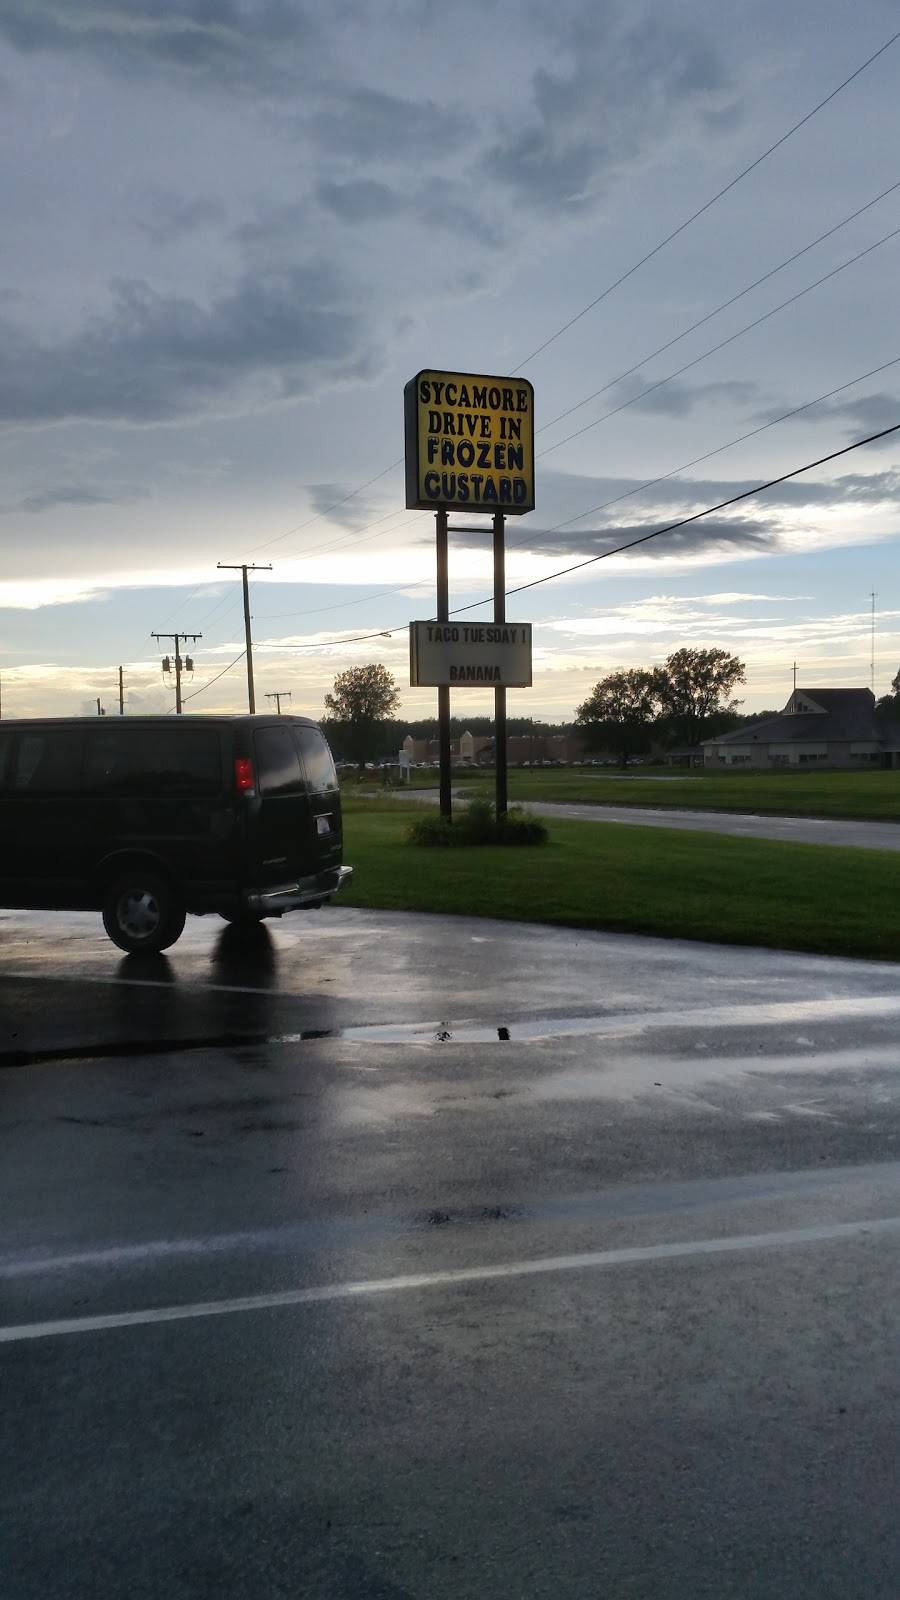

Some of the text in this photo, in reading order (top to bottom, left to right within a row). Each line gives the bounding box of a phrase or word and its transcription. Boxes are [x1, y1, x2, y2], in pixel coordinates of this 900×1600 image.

[420, 381, 528, 412] SYCAMORE
[428, 411, 522, 440] DRIVE IN
[427, 436, 524, 471] FROZEN
[424, 470, 528, 503] CUSTARD
[427, 627, 459, 642] TACO
[463, 627, 517, 644] TUESDAY
[449, 665, 501, 681] BANANA
